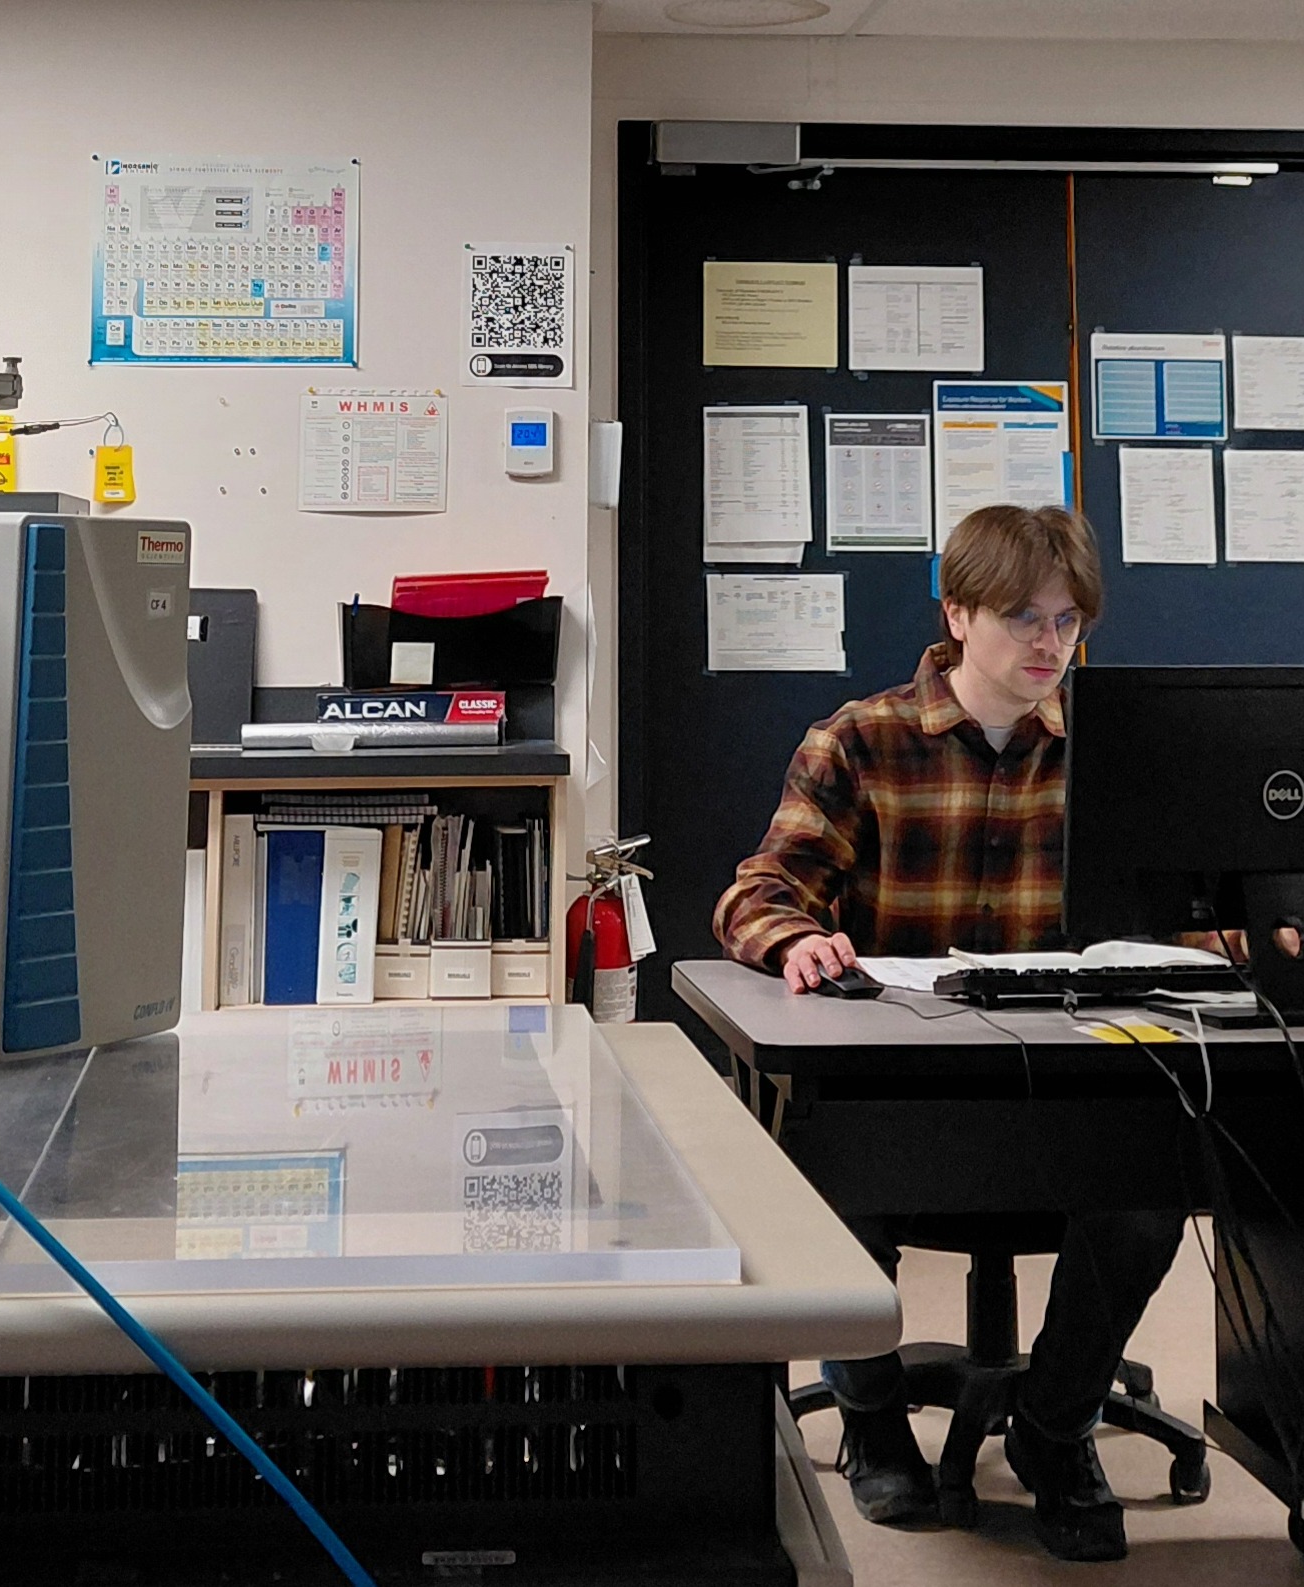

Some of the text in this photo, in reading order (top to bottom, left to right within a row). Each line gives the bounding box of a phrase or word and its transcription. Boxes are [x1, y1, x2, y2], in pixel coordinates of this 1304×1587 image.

[338, 400, 409, 412] WHMIS
[140, 536, 184, 552] Thermo
[150, 598, 166, 610] CF 4
[322, 701, 426, 719] ALCAN
[458, 700, 497, 709] CLASSIC
[1268, 788, 1302, 801] DELL
